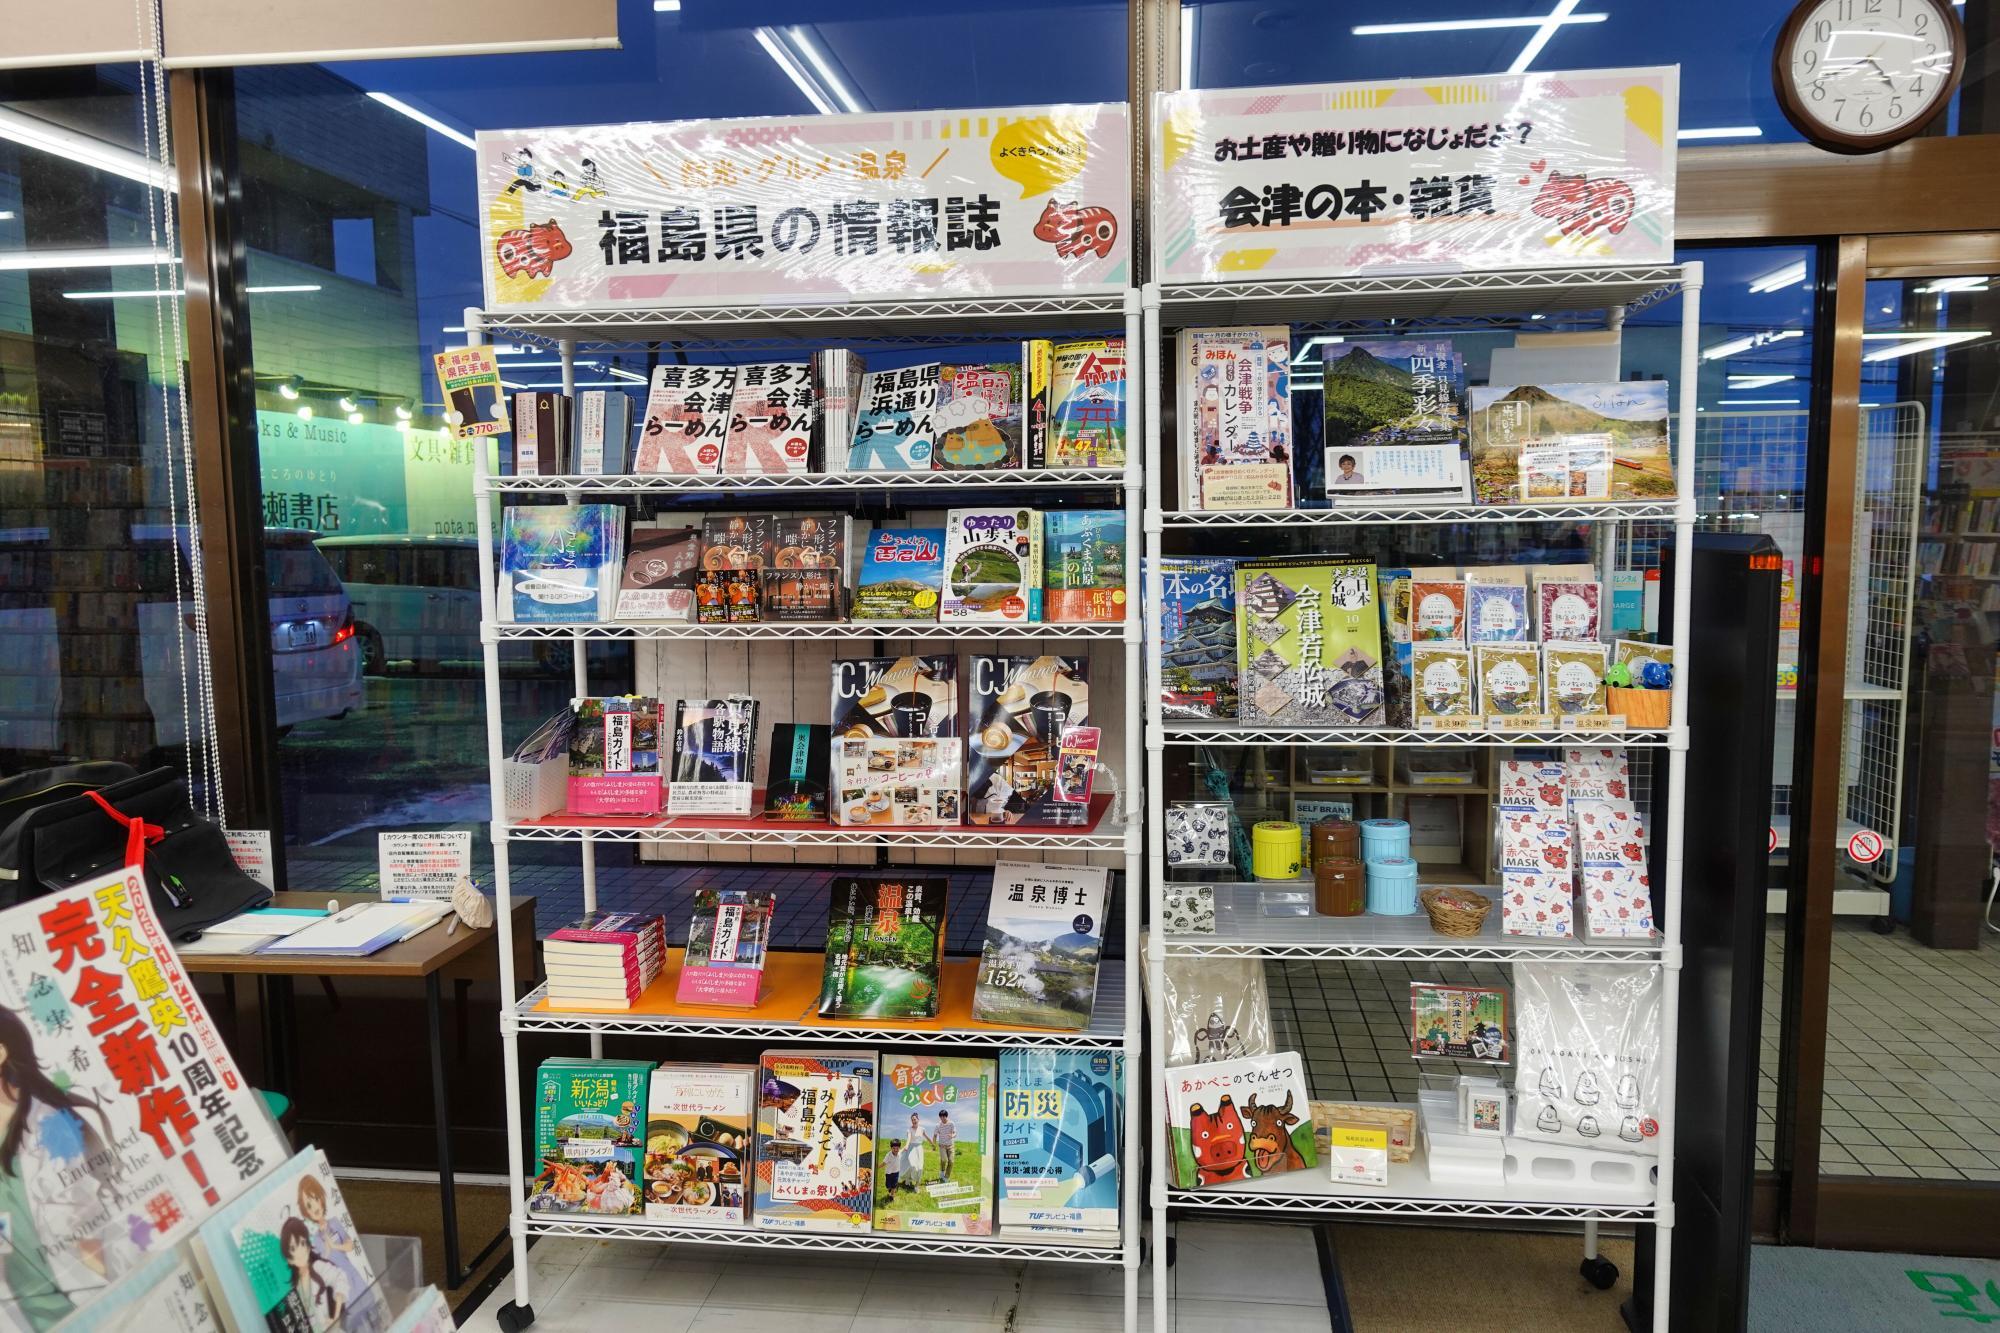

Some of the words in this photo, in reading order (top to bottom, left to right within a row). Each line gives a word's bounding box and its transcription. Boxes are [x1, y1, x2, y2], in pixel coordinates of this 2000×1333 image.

[1814, 20, 1833, 43] 10
[1914, 14, 1928, 36] 2
[1803, 50, 1817, 74] 9
[1811, 79, 1825, 101] 8
[1909, 76, 1924, 97] 4
[1834, 99, 1846, 122] 7
[1859, 104, 1873, 127] 6
[1888, 97, 1902, 119] 5
[598, 194, 1002, 266] 福島県の情報誌
[1205, 350, 1236, 360] みほん
[662, 366, 737, 389] 喜多方
[874, 365, 941, 394] 福島県
[1238, 358, 1253, 414] 会津戦争
[683, 391, 731, 414] 会津
[766, 387, 812, 409] 会津
[869, 390, 936, 417] 浜通り
[1411, 356, 1438, 433] 四季彩々
[646, 415, 727, 438] らーめん
[729, 413, 812, 433] らーめん
[855, 414, 934, 439] らーめん
[1223, 384, 1239, 452] カレンダー
[303, 424, 348, 444] Music
[951, 516, 959, 534] 東北
[966, 518, 1012, 527] ゆったり
[742, 521, 752, 553] 人形は
[755, 519, 765, 555] フランス
[813, 521, 824, 553] 人形は
[827, 519, 837, 556] フランス
[963, 527, 1017, 545] 山歩き
[1080, 514, 1095, 585] あぶくま高原
[765, 571, 822, 580] フランス人形は
[1067, 562, 1080, 586] の山
[1331, 578, 1347, 607] 名城
[1356, 579, 1371, 606] 日本
[952, 609, 968, 617] 58
[1092, 591, 1106, 618] 低山
[1295, 583, 1327, 708] 会津若松城
[838, 661, 870, 698] CJ
[976, 657, 1009, 696] CJ
[711, 702, 725, 753] 各駅物語
[724, 703, 743, 753] 只見線
[612, 715, 623, 770] 福島ガイド
[1503, 797, 1536, 806] MASK
[1570, 789, 1604, 798] MASK
[1297, 804, 1318, 812] SELF
[1506, 858, 1540, 868] MASK
[1585, 852, 1621, 861] MASK
[1008, 883, 1088, 906] 温泉博士
[875, 883, 903, 933] 温泉
[719, 906, 736, 959] 福島ガイド
[93, 882, 188, 1038] 天久鷹央
[168, 1032, 266, 1180] 10周年記念
[39, 897, 222, 1207] 完全新作!
[893, 1065, 941, 1087] 育なび
[1181, 1066, 1294, 1093] あかべこのでんせつ
[570, 1078, 609, 1100] 新潟
[902, 1084, 957, 1105] ふくしま
[672, 1103, 727, 1112] 次世代ラーメン
[800, 1088, 817, 1124] 福島
[1004, 1091, 1060, 1118] 防災
[818, 1088, 834, 1166] みんなで!
[1003, 1122, 1037, 1135] ガイド
[57, 1127, 140, 1188] Entrapped
[123, 1151, 151, 1176] the
[1003, 1165, 1063, 1175] 防災・減災の心得
[113, 1172, 165, 1212] Prison
[776, 1184, 839, 1197] ふくしまの祭り
[670, 1206, 719, 1215] 次世代ラーメン
[911, 1218, 925, 1226] TUF
[1029, 1212, 1046, 1220] TUF
